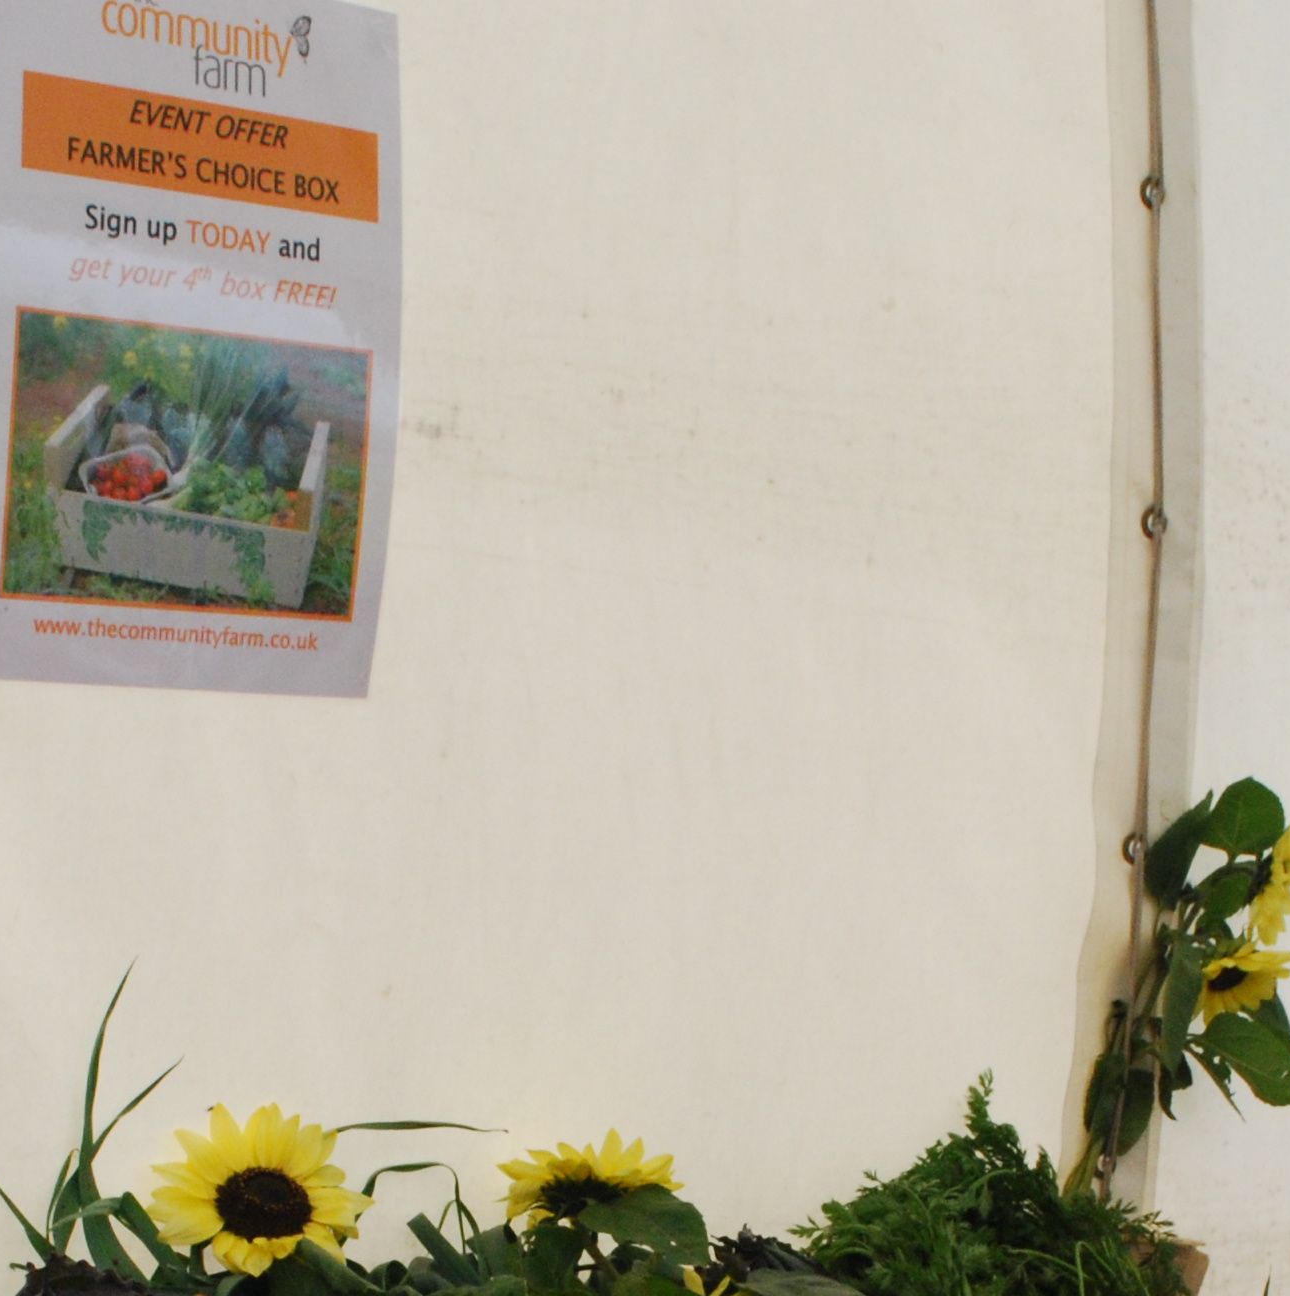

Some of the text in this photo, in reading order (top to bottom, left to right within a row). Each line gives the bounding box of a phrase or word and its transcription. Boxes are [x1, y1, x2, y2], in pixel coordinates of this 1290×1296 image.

[101, 0, 293, 78] community
[193, 44, 266, 97] farm
[129, 99, 289, 149] EVENT OFFER
[67, 136, 340, 204] FARMER'S CHOICE BOX
[85, 204, 321, 262] Sign up TODAY and
[68, 256, 338, 309] get your 4th box FREE!
[33, 617, 319, 652] www.thecommunityfarm.co.uk
